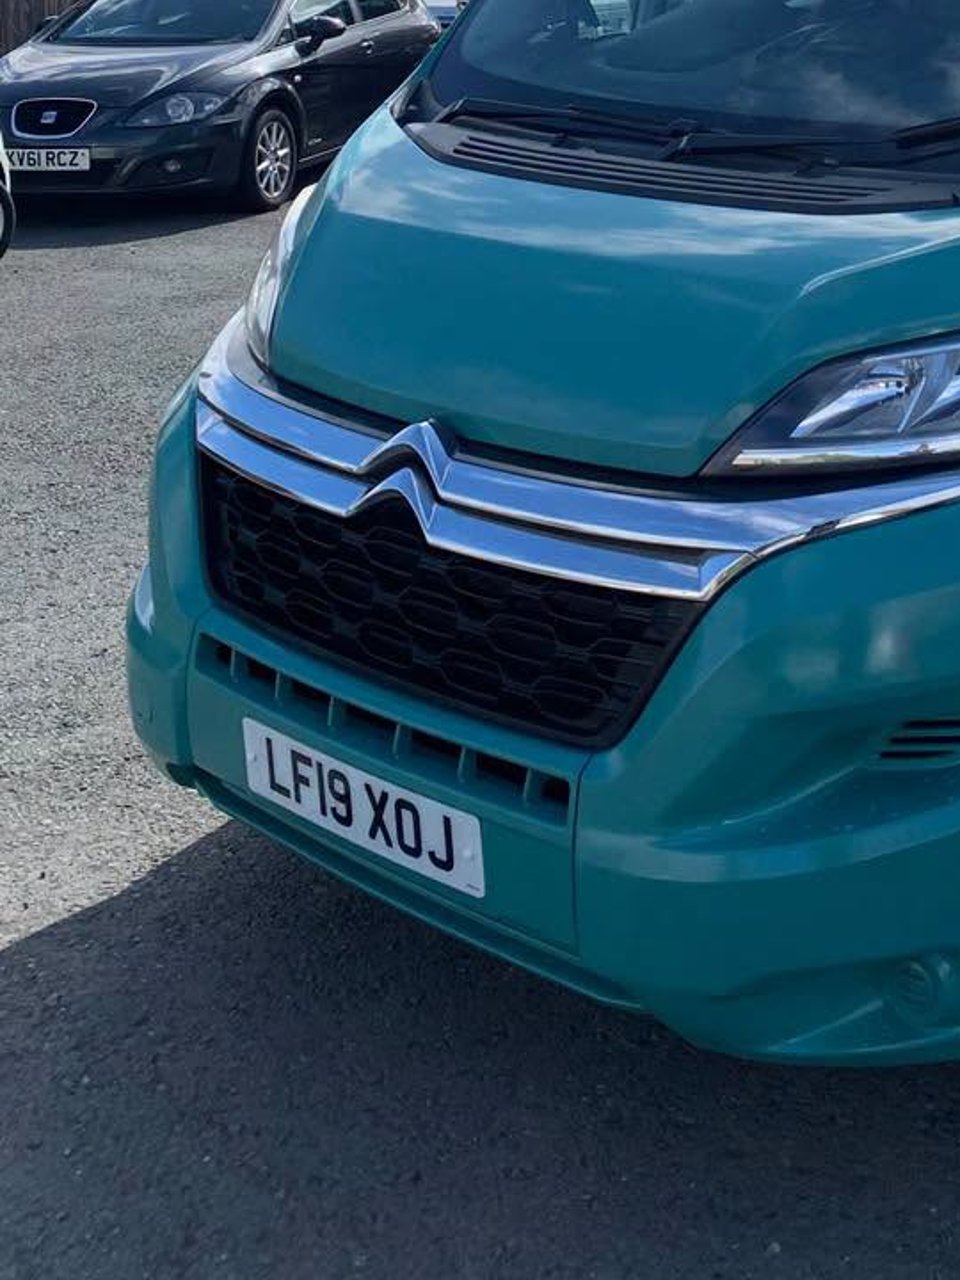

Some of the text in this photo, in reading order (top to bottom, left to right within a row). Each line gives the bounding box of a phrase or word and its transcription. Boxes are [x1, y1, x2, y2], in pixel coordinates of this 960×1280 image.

[46, 150, 79, 167] RCZ
[265, 737, 455, 872] LF19 XOJ
